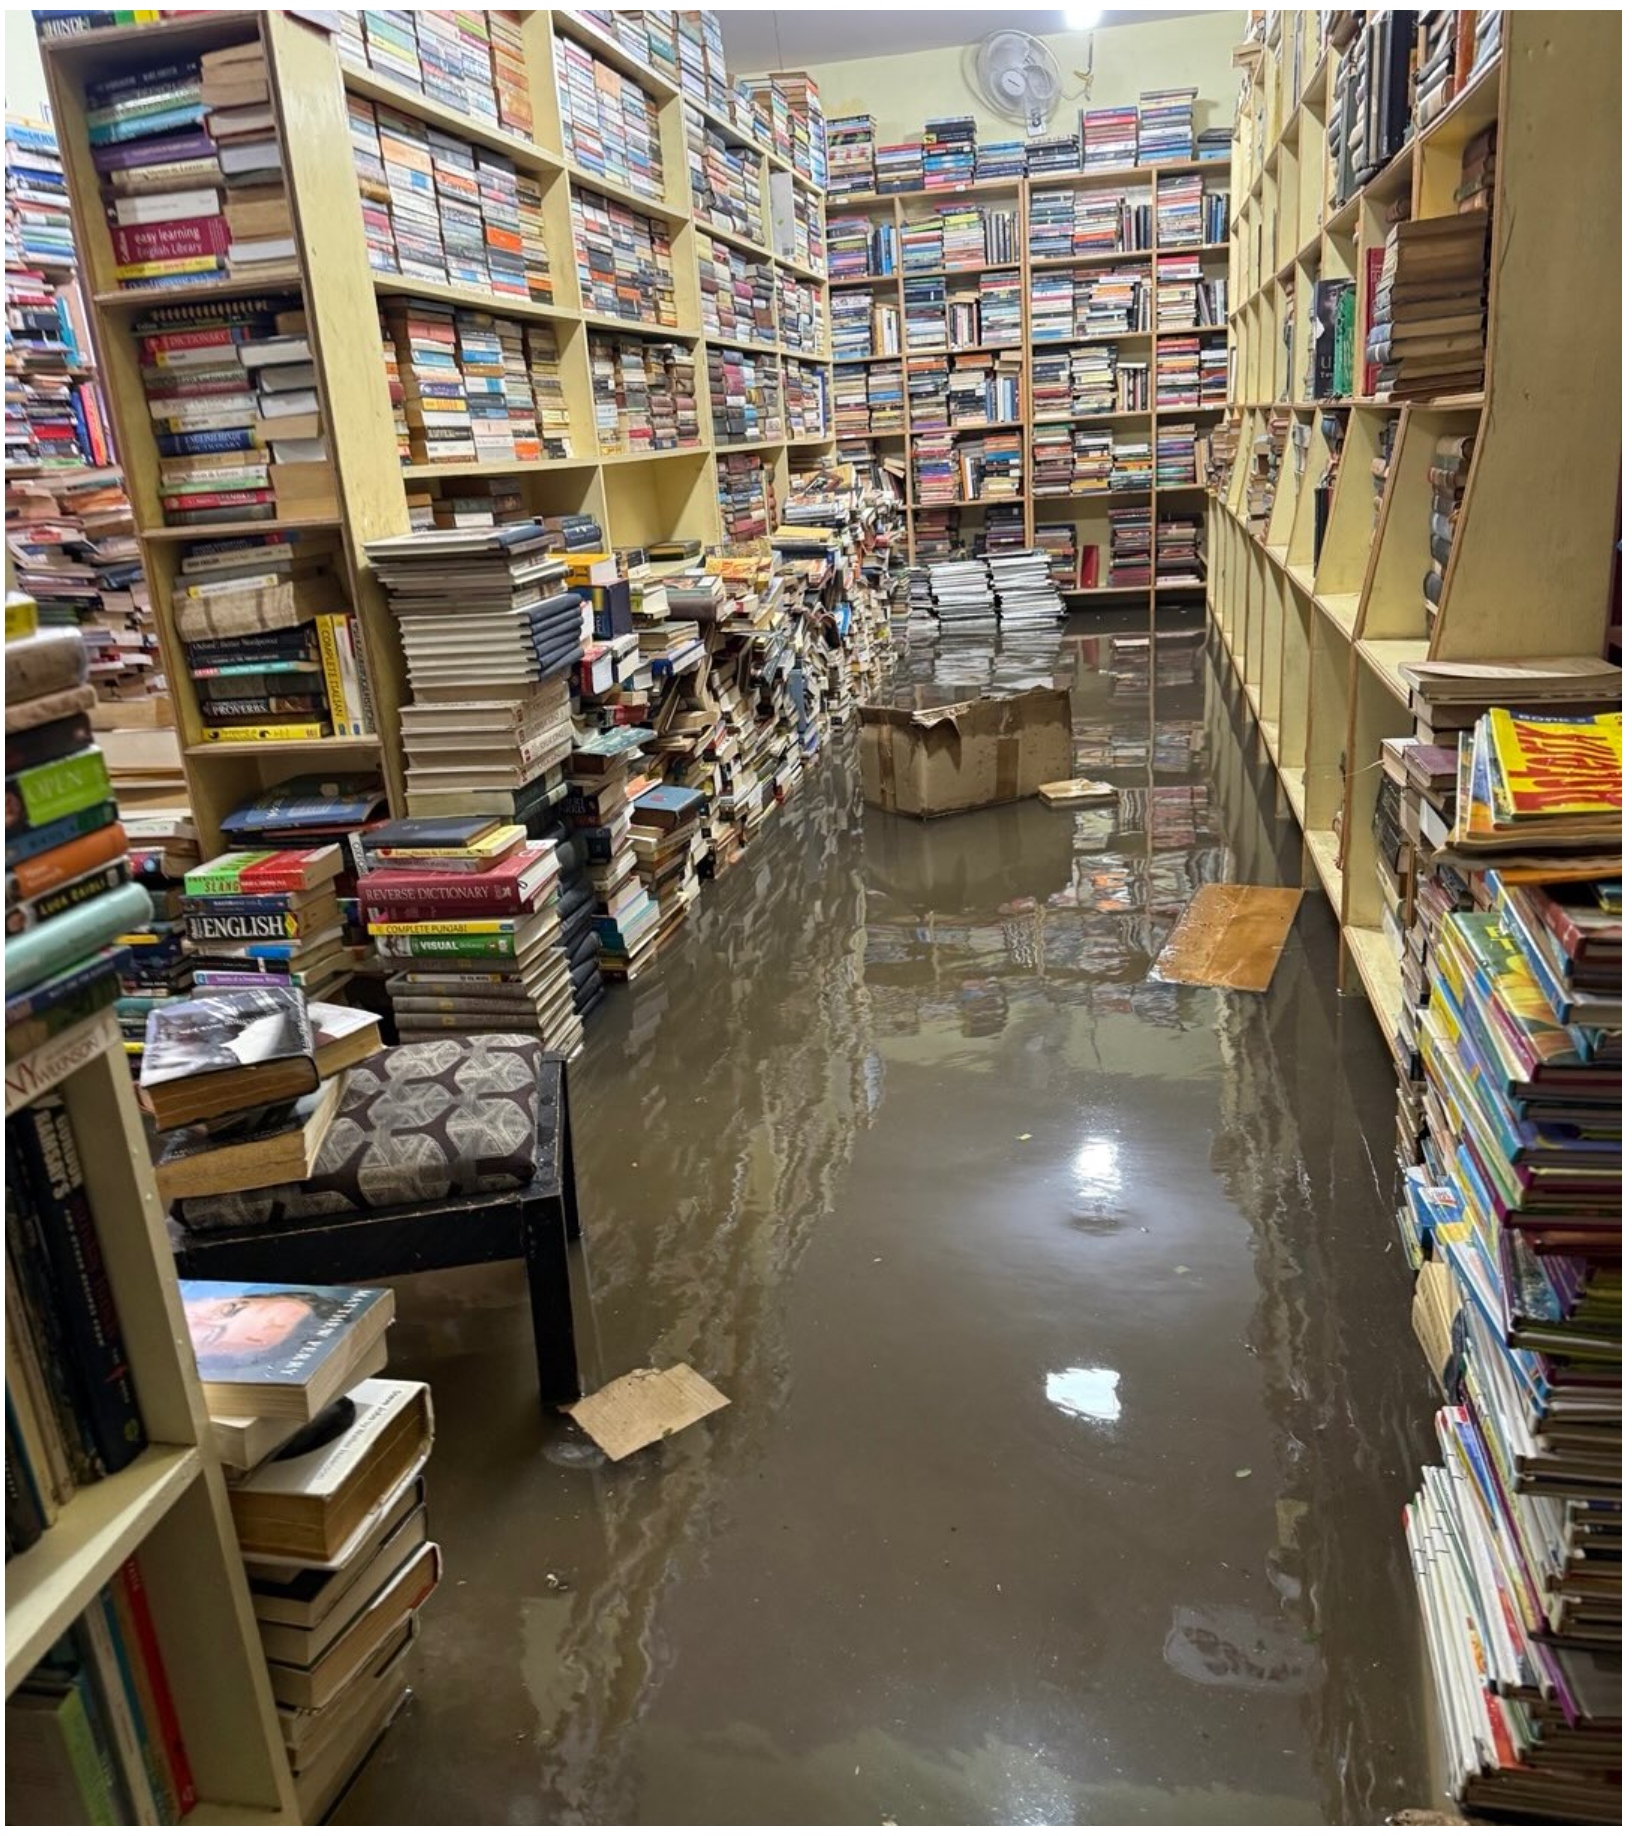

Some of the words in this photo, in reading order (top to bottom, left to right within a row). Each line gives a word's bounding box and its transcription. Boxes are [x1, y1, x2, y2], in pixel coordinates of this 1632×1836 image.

[134, 233, 157, 246] easy
[160, 227, 200, 243] learning
[321, 628, 341, 679] COMPLETE
[204, 880, 240, 893] SLANG
[365, 888, 415, 901] REVERSE
[417, 886, 489, 900] DICTIONARY
[203, 915, 285, 938] ENGLISH
[386, 925, 429, 934] COMPLETE
[431, 924, 468, 934] PUNJABI
[420, 941, 459, 951] VISUAL
